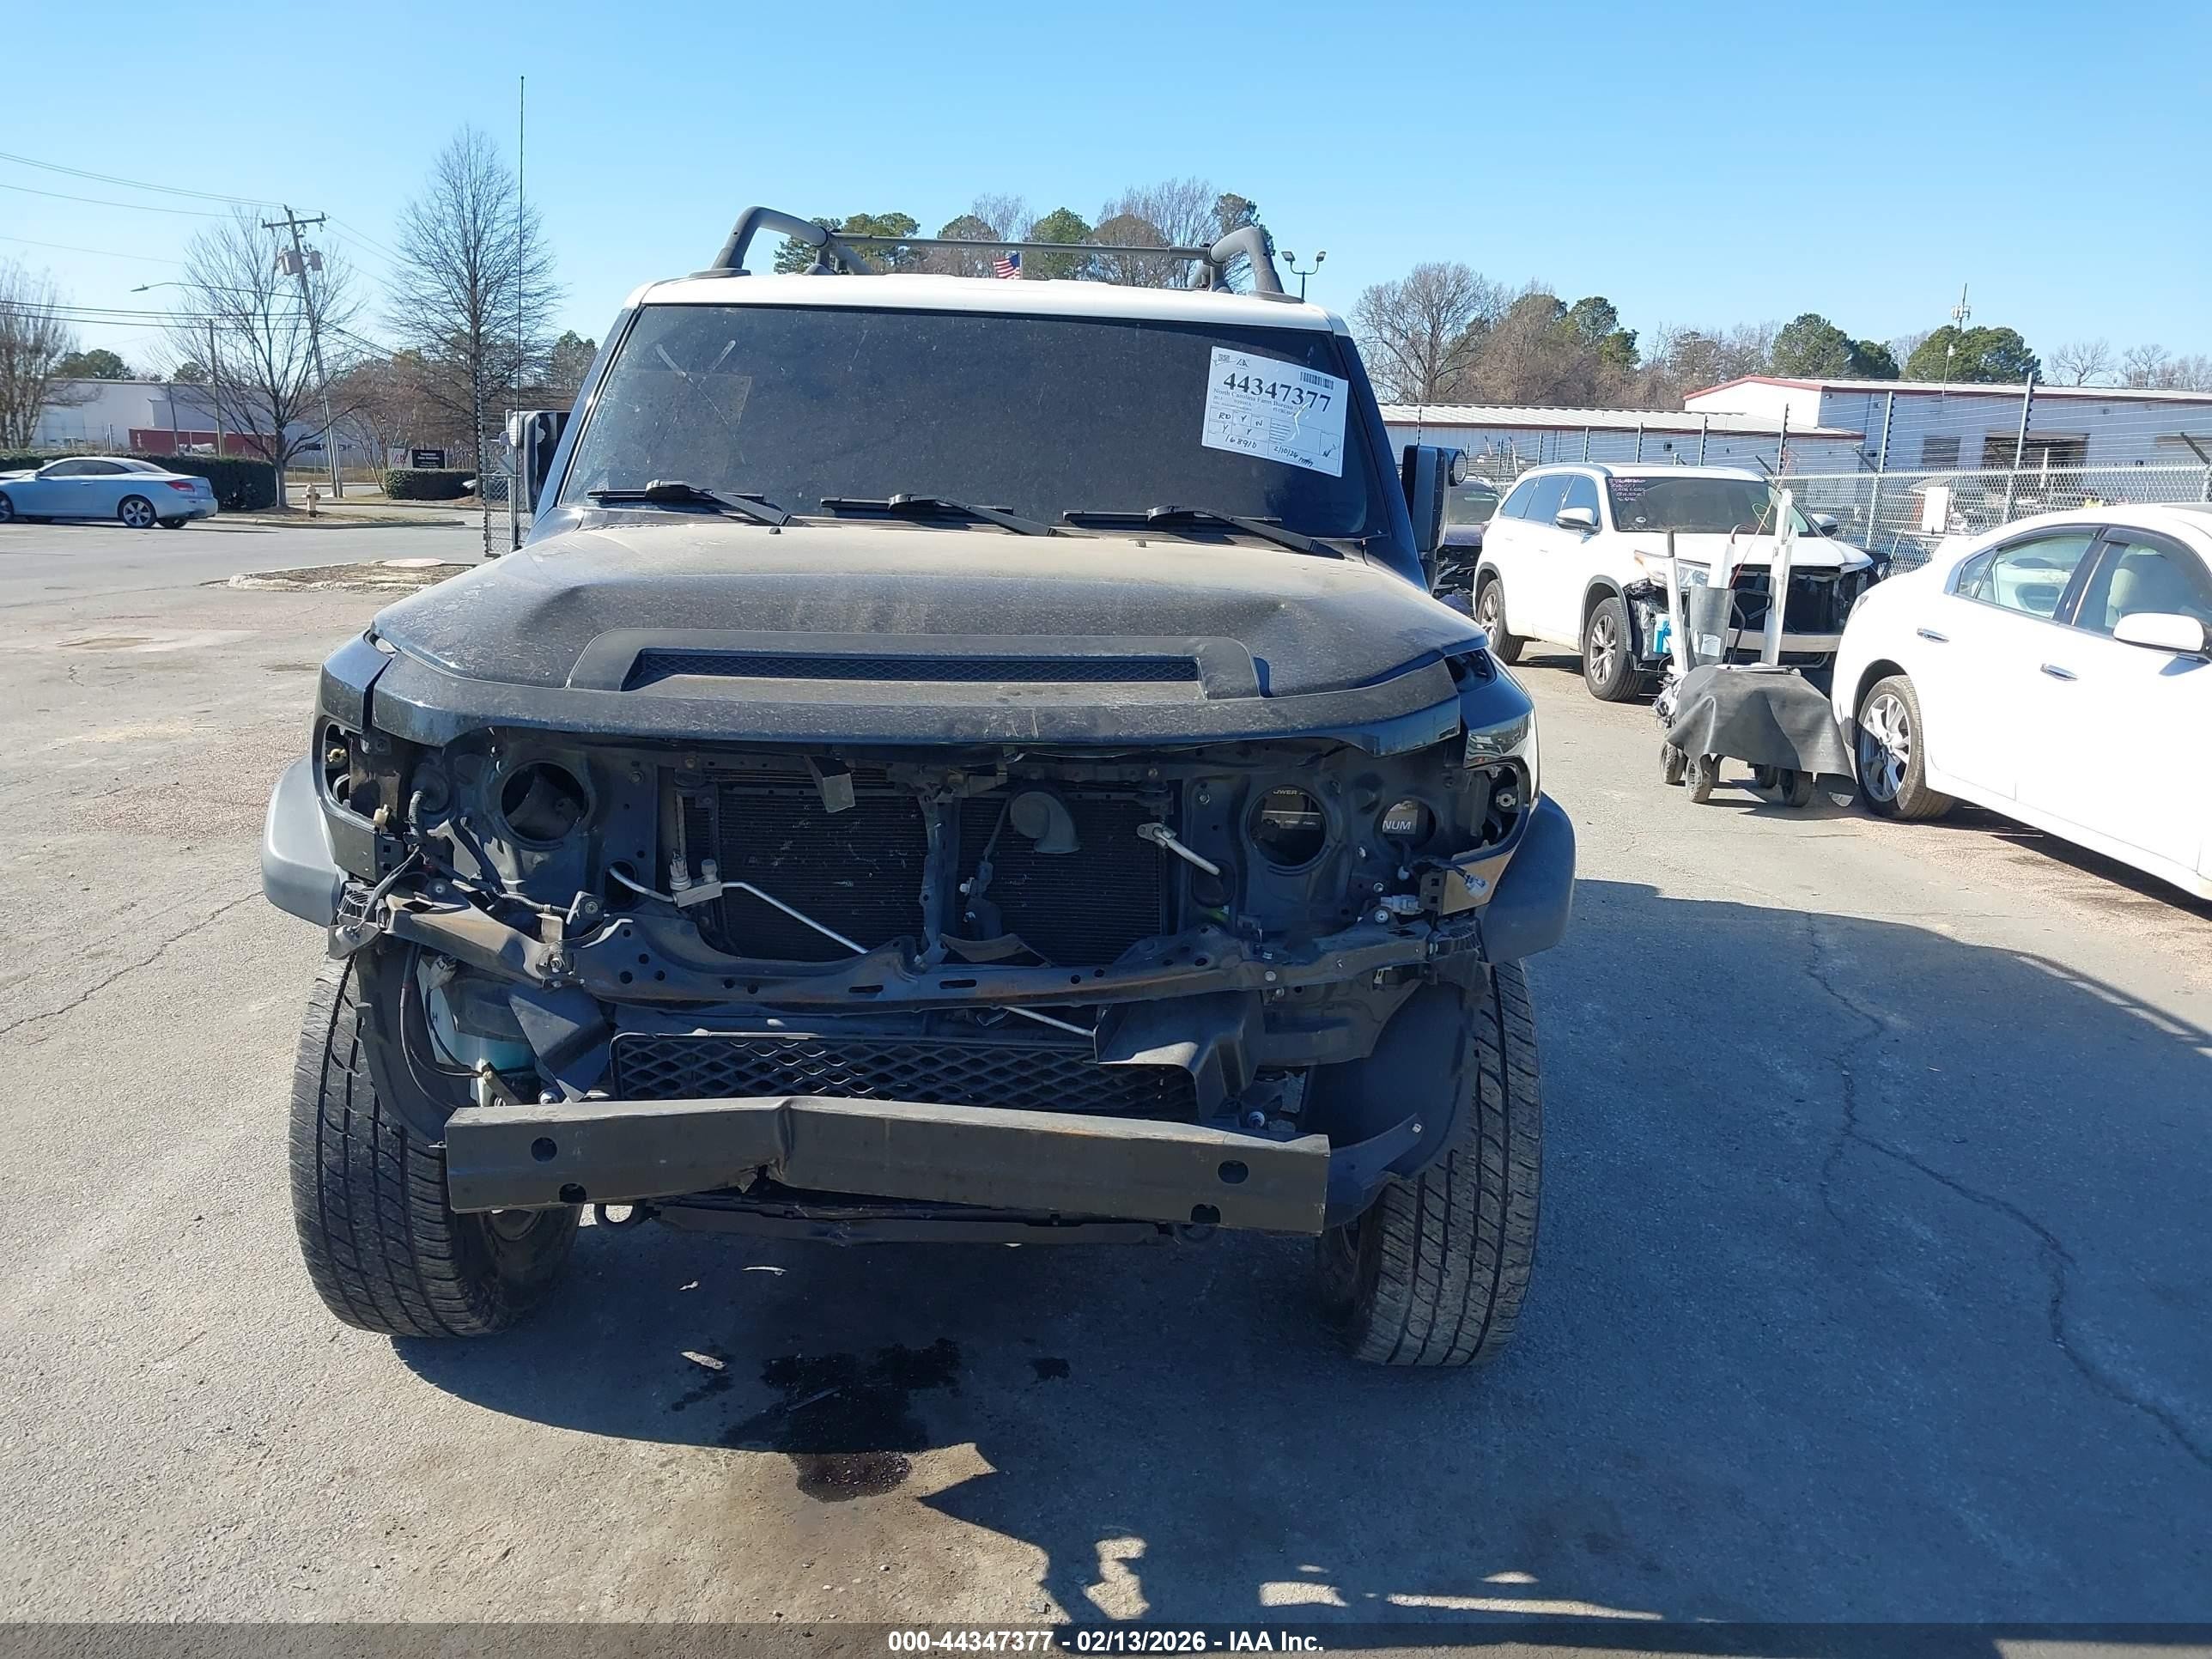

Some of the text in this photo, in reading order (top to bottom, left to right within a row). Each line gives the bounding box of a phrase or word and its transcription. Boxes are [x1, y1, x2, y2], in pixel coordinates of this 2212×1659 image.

[1213, 387, 1231, 397] North
[1231, 391, 1256, 402] Carolina
[1257, 396, 1272, 404] Farm
[1223, 372, 1332, 412] 44347377
[1382, 820, 1412, 830] NUM
